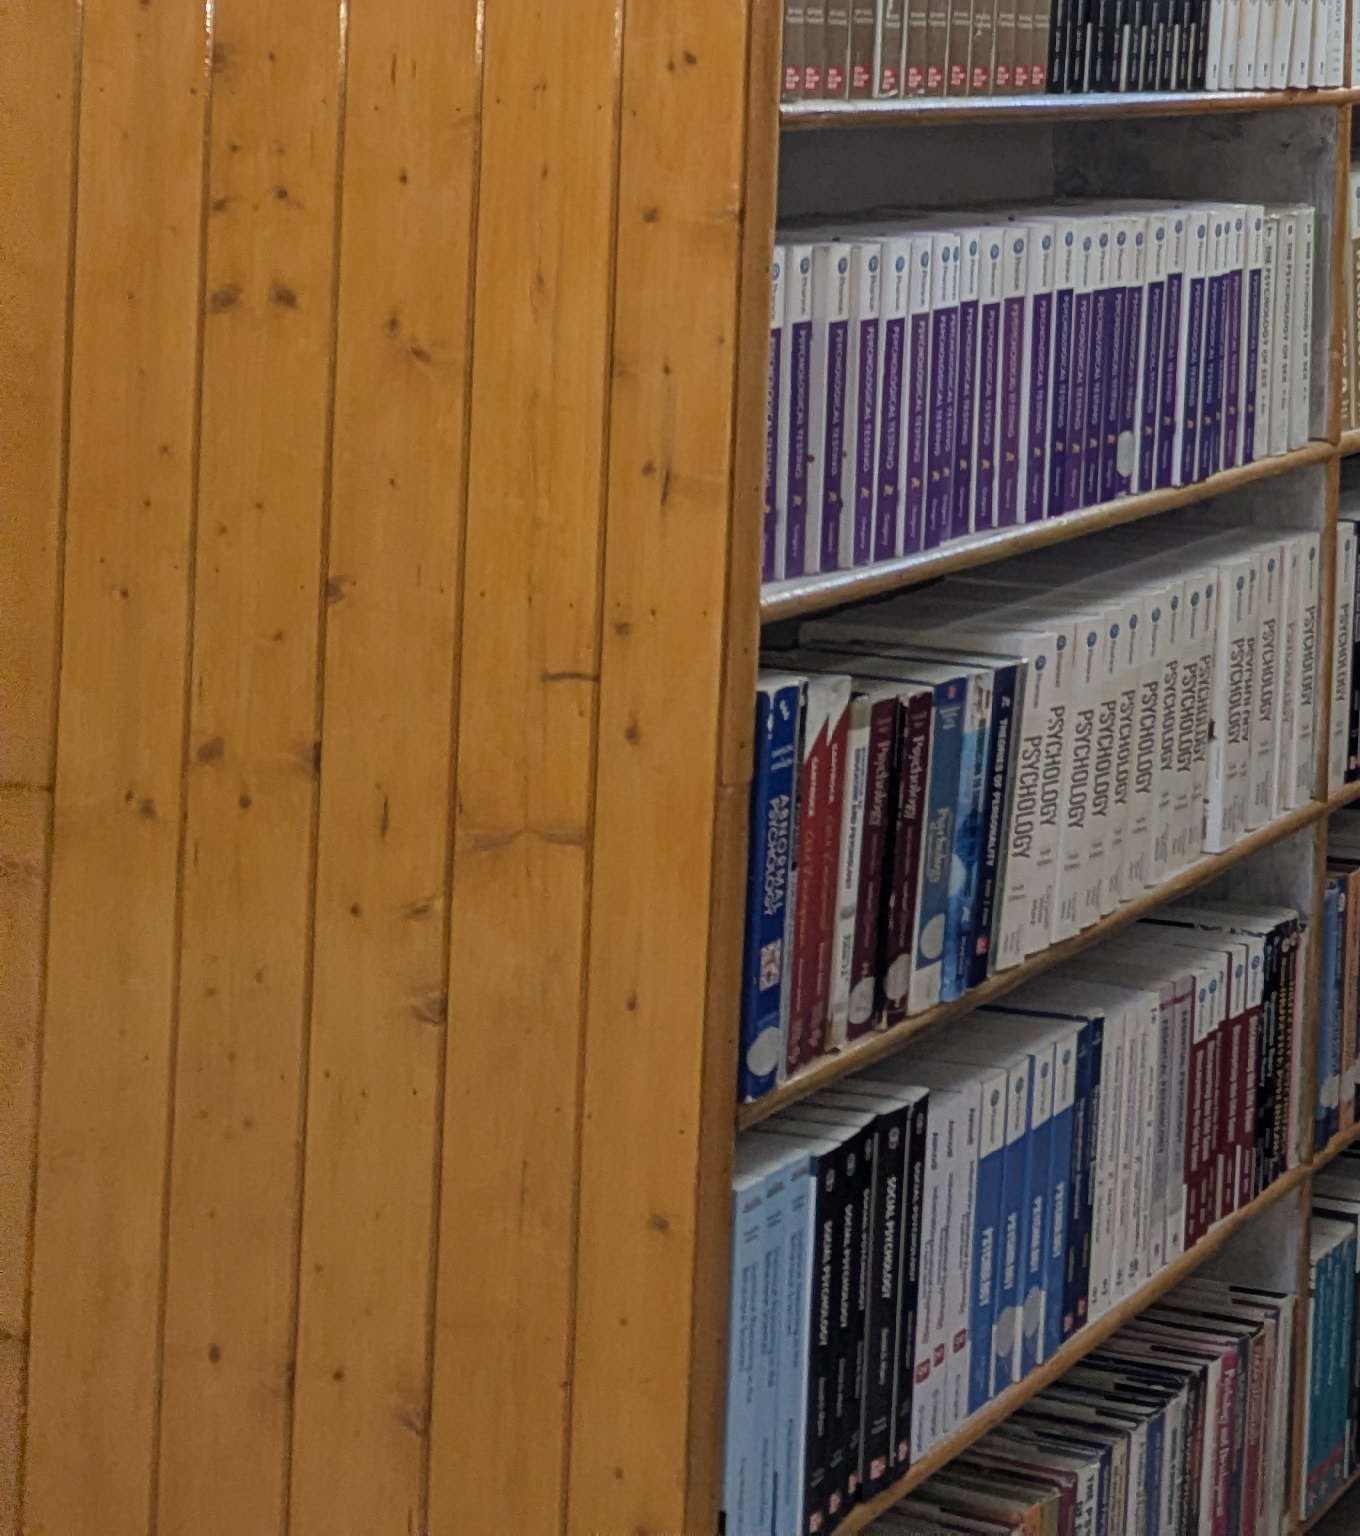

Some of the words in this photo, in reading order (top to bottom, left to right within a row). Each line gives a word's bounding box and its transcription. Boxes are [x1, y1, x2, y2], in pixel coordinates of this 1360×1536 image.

[1259, 619, 1275, 722] PSYCHOLOGY
[1134, 682, 1158, 794] PSYCHOLOGY
[1012, 737, 1042, 858] PSYCHOLOGY
